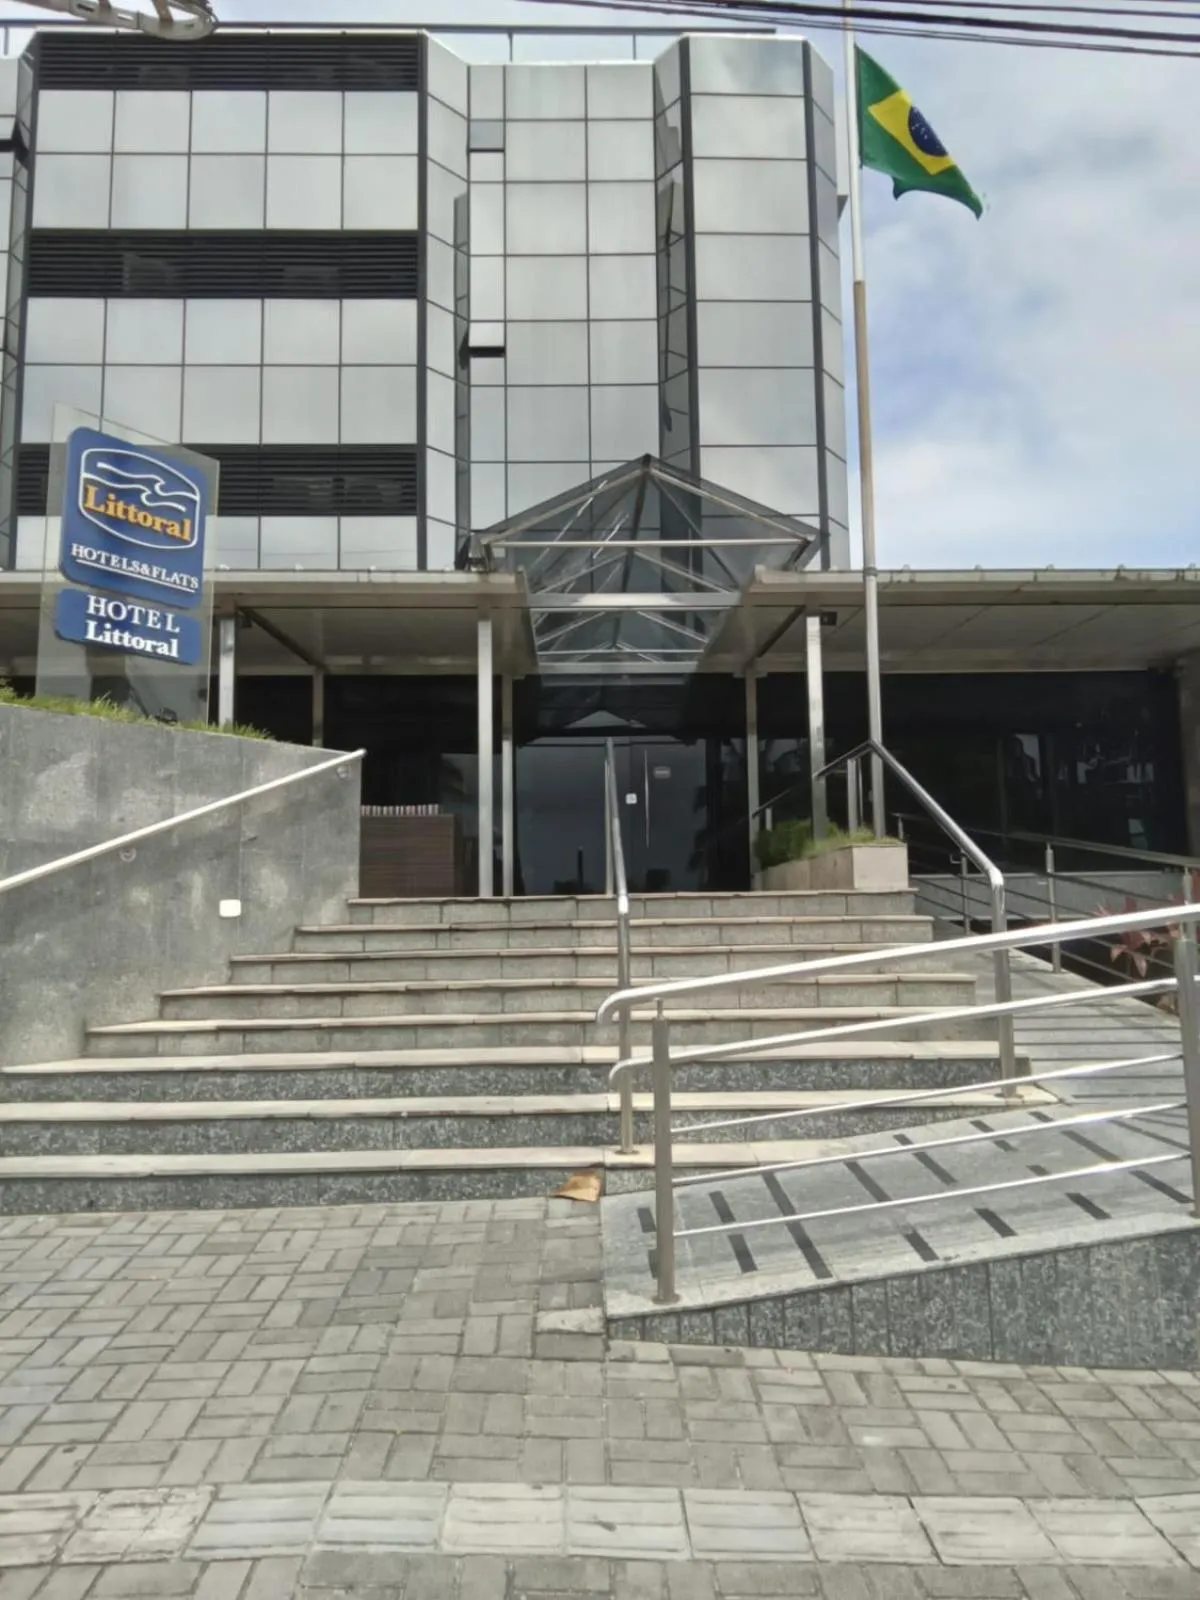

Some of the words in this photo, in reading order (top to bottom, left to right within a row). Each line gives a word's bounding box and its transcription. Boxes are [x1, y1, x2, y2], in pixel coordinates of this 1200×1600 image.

[84, 484, 191, 541] Littoral
[71, 543, 199, 589] HOTELS&FLATS
[86, 595, 181, 633] HOTEL
[85, 620, 179, 658] Littoral
